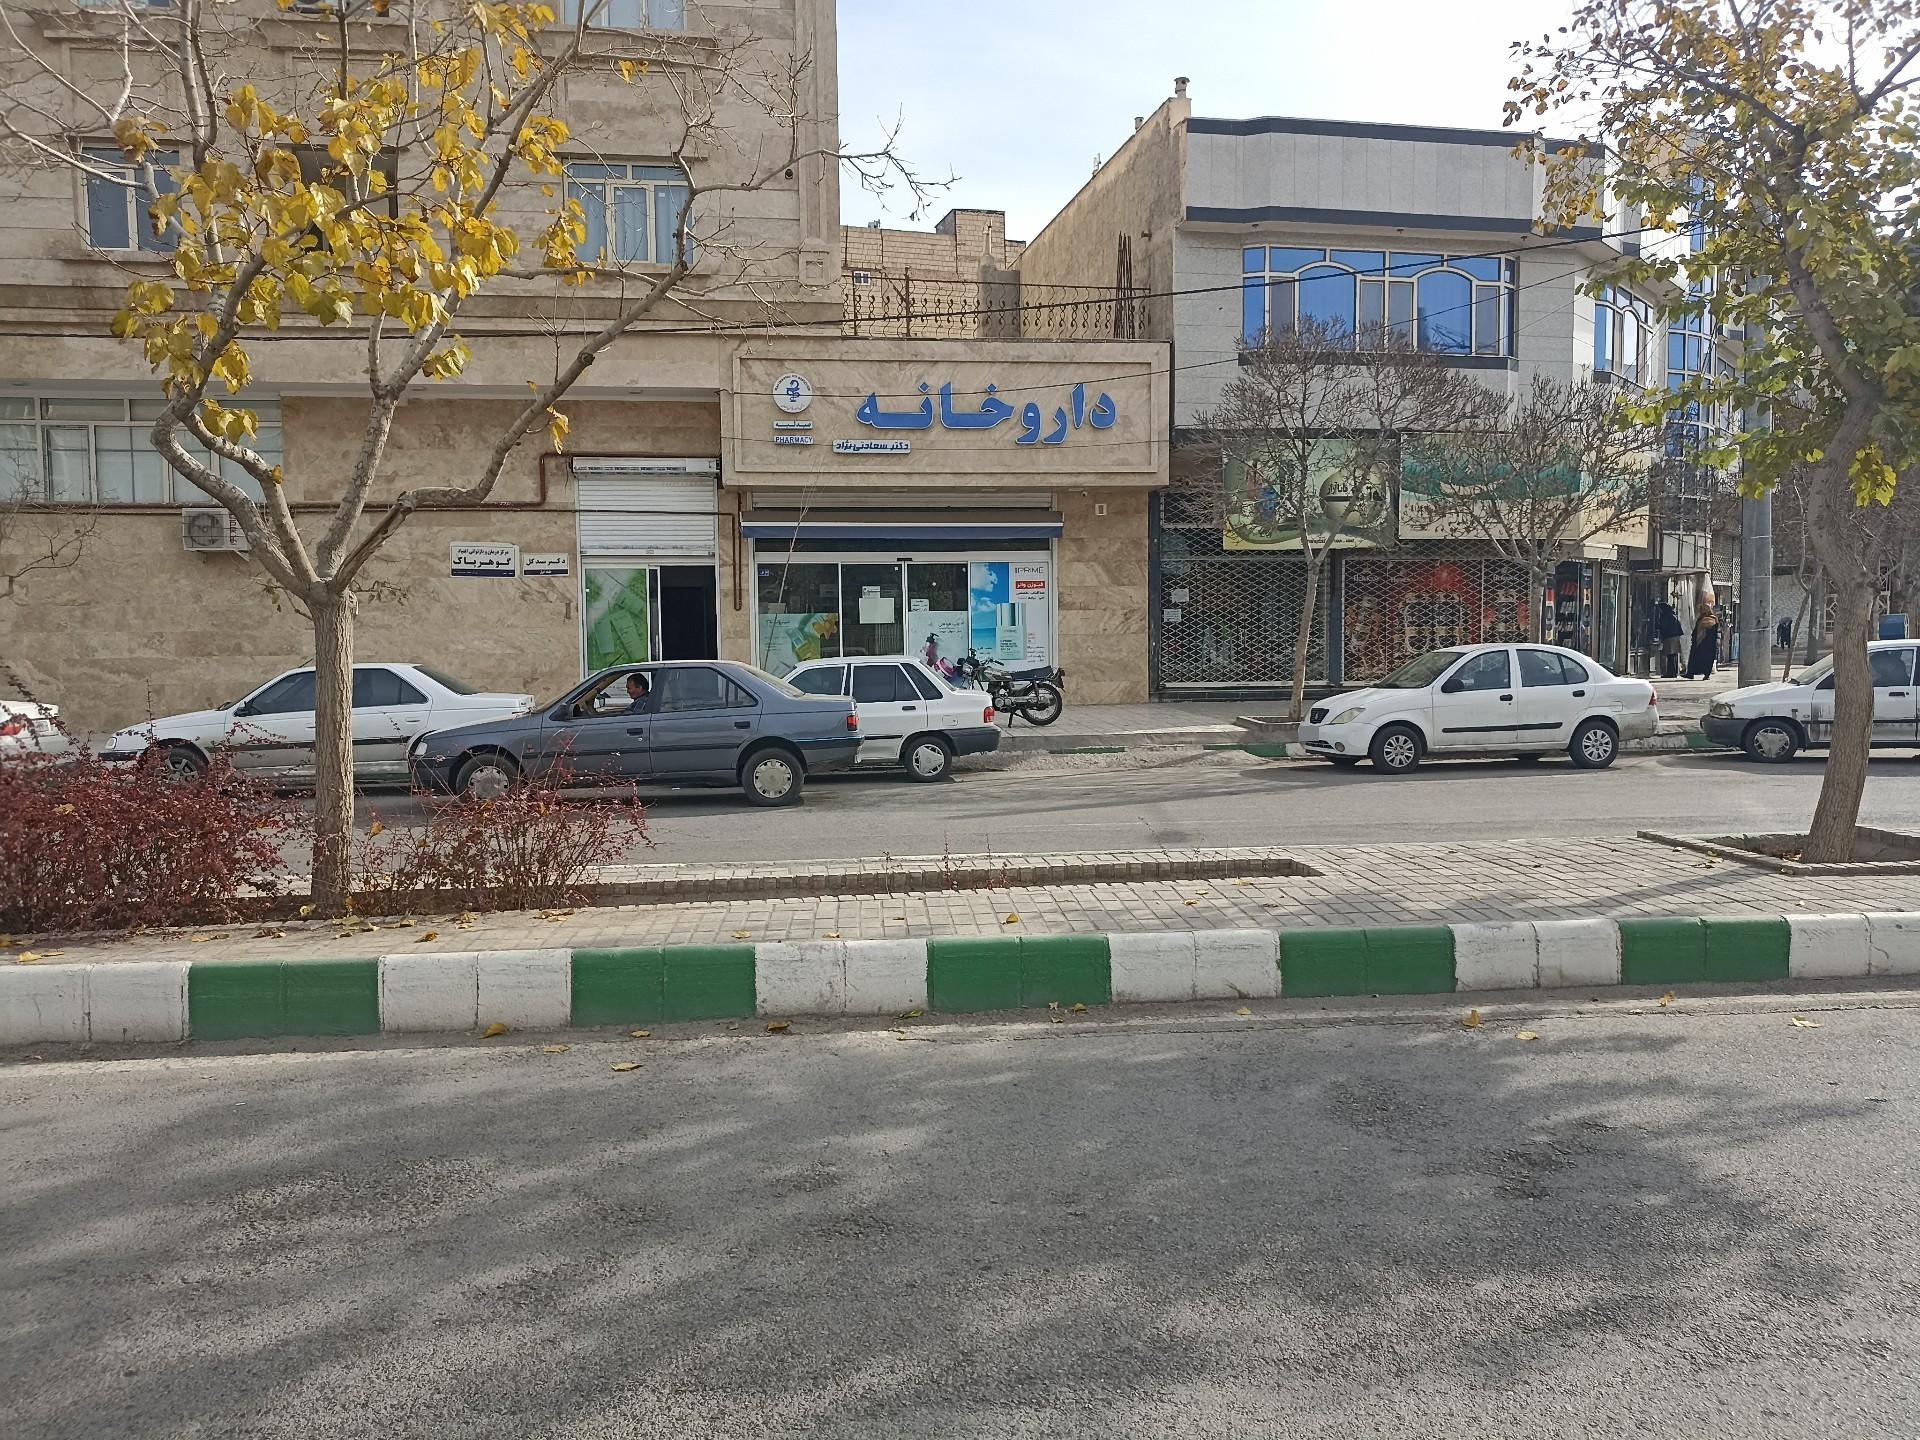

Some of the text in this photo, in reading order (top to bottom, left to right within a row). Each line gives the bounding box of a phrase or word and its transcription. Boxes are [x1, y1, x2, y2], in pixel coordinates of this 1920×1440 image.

[856, 380, 1117, 444] داروخانه
[888, 441, 909, 451] دکتر
[453, 556, 477, 568] پاک
